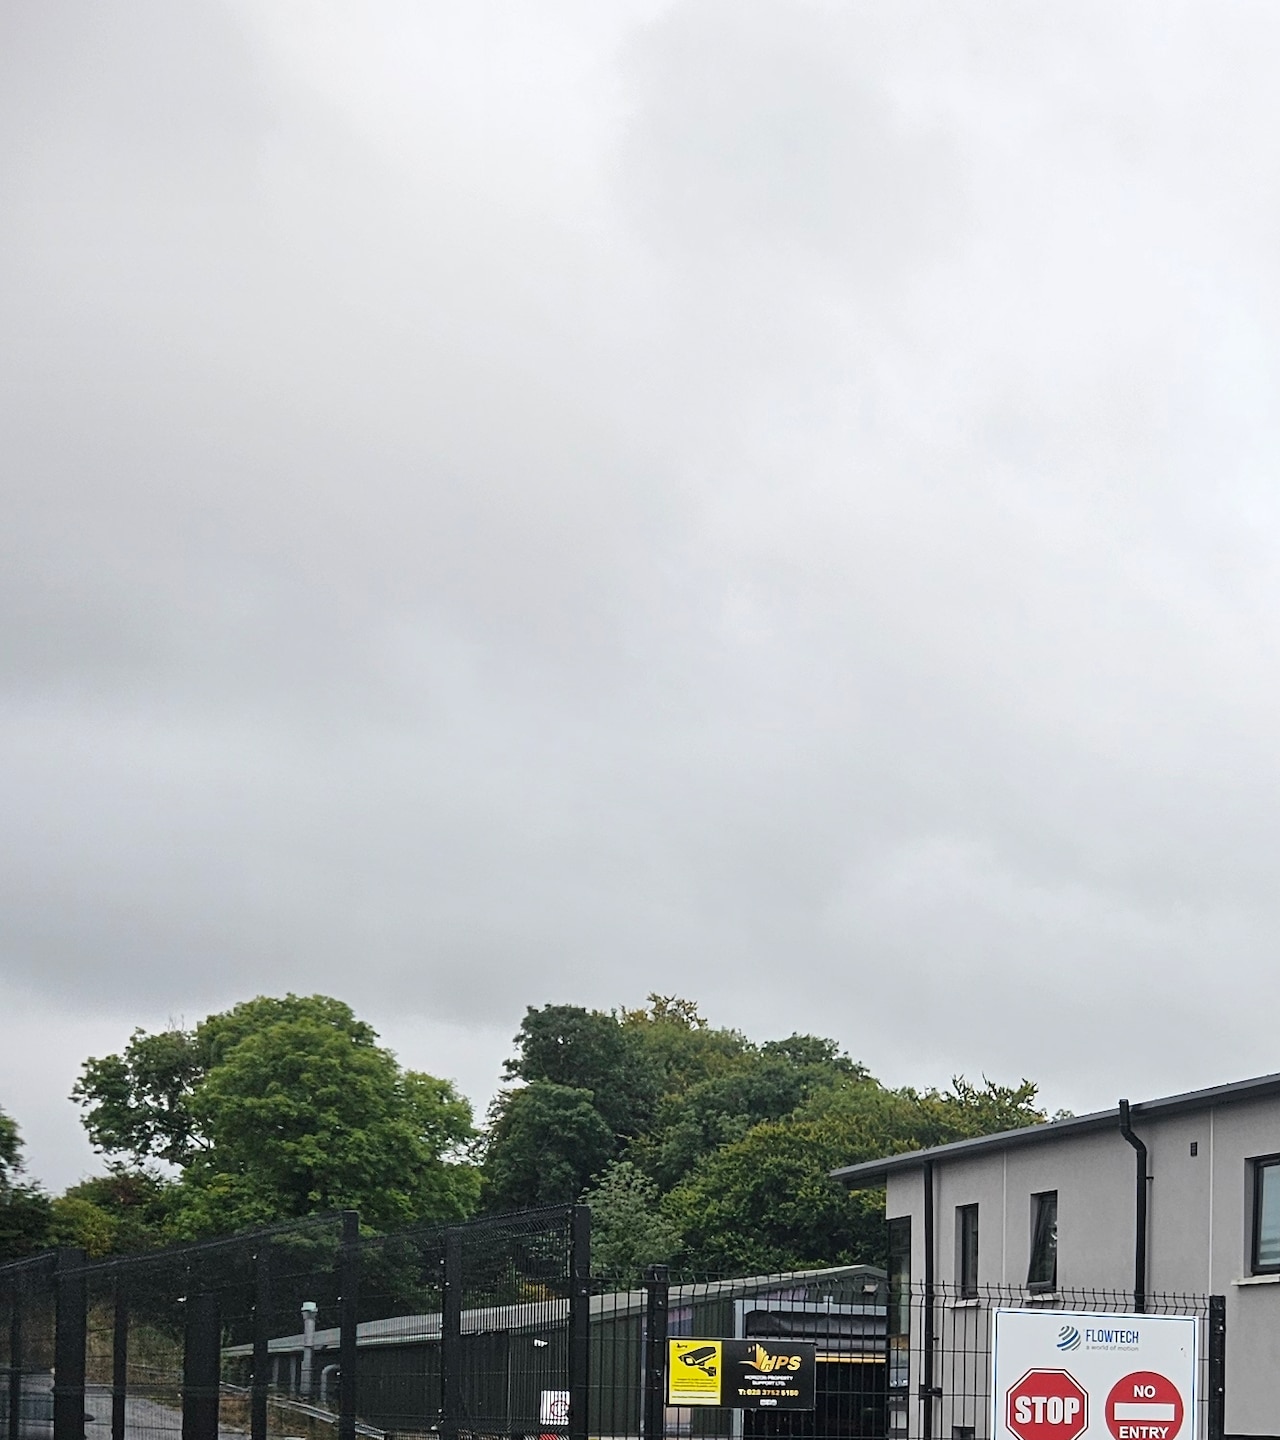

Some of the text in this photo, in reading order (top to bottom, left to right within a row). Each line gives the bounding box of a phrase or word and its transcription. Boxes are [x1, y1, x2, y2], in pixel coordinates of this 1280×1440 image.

[1086, 1329, 1139, 1344] FLOWTECH
[760, 1355, 802, 1371] HPS
[1133, 1384, 1156, 1399] NO
[1015, 1395, 1080, 1425] STOP
[1119, 1425, 1169, 1439] ENTRY
